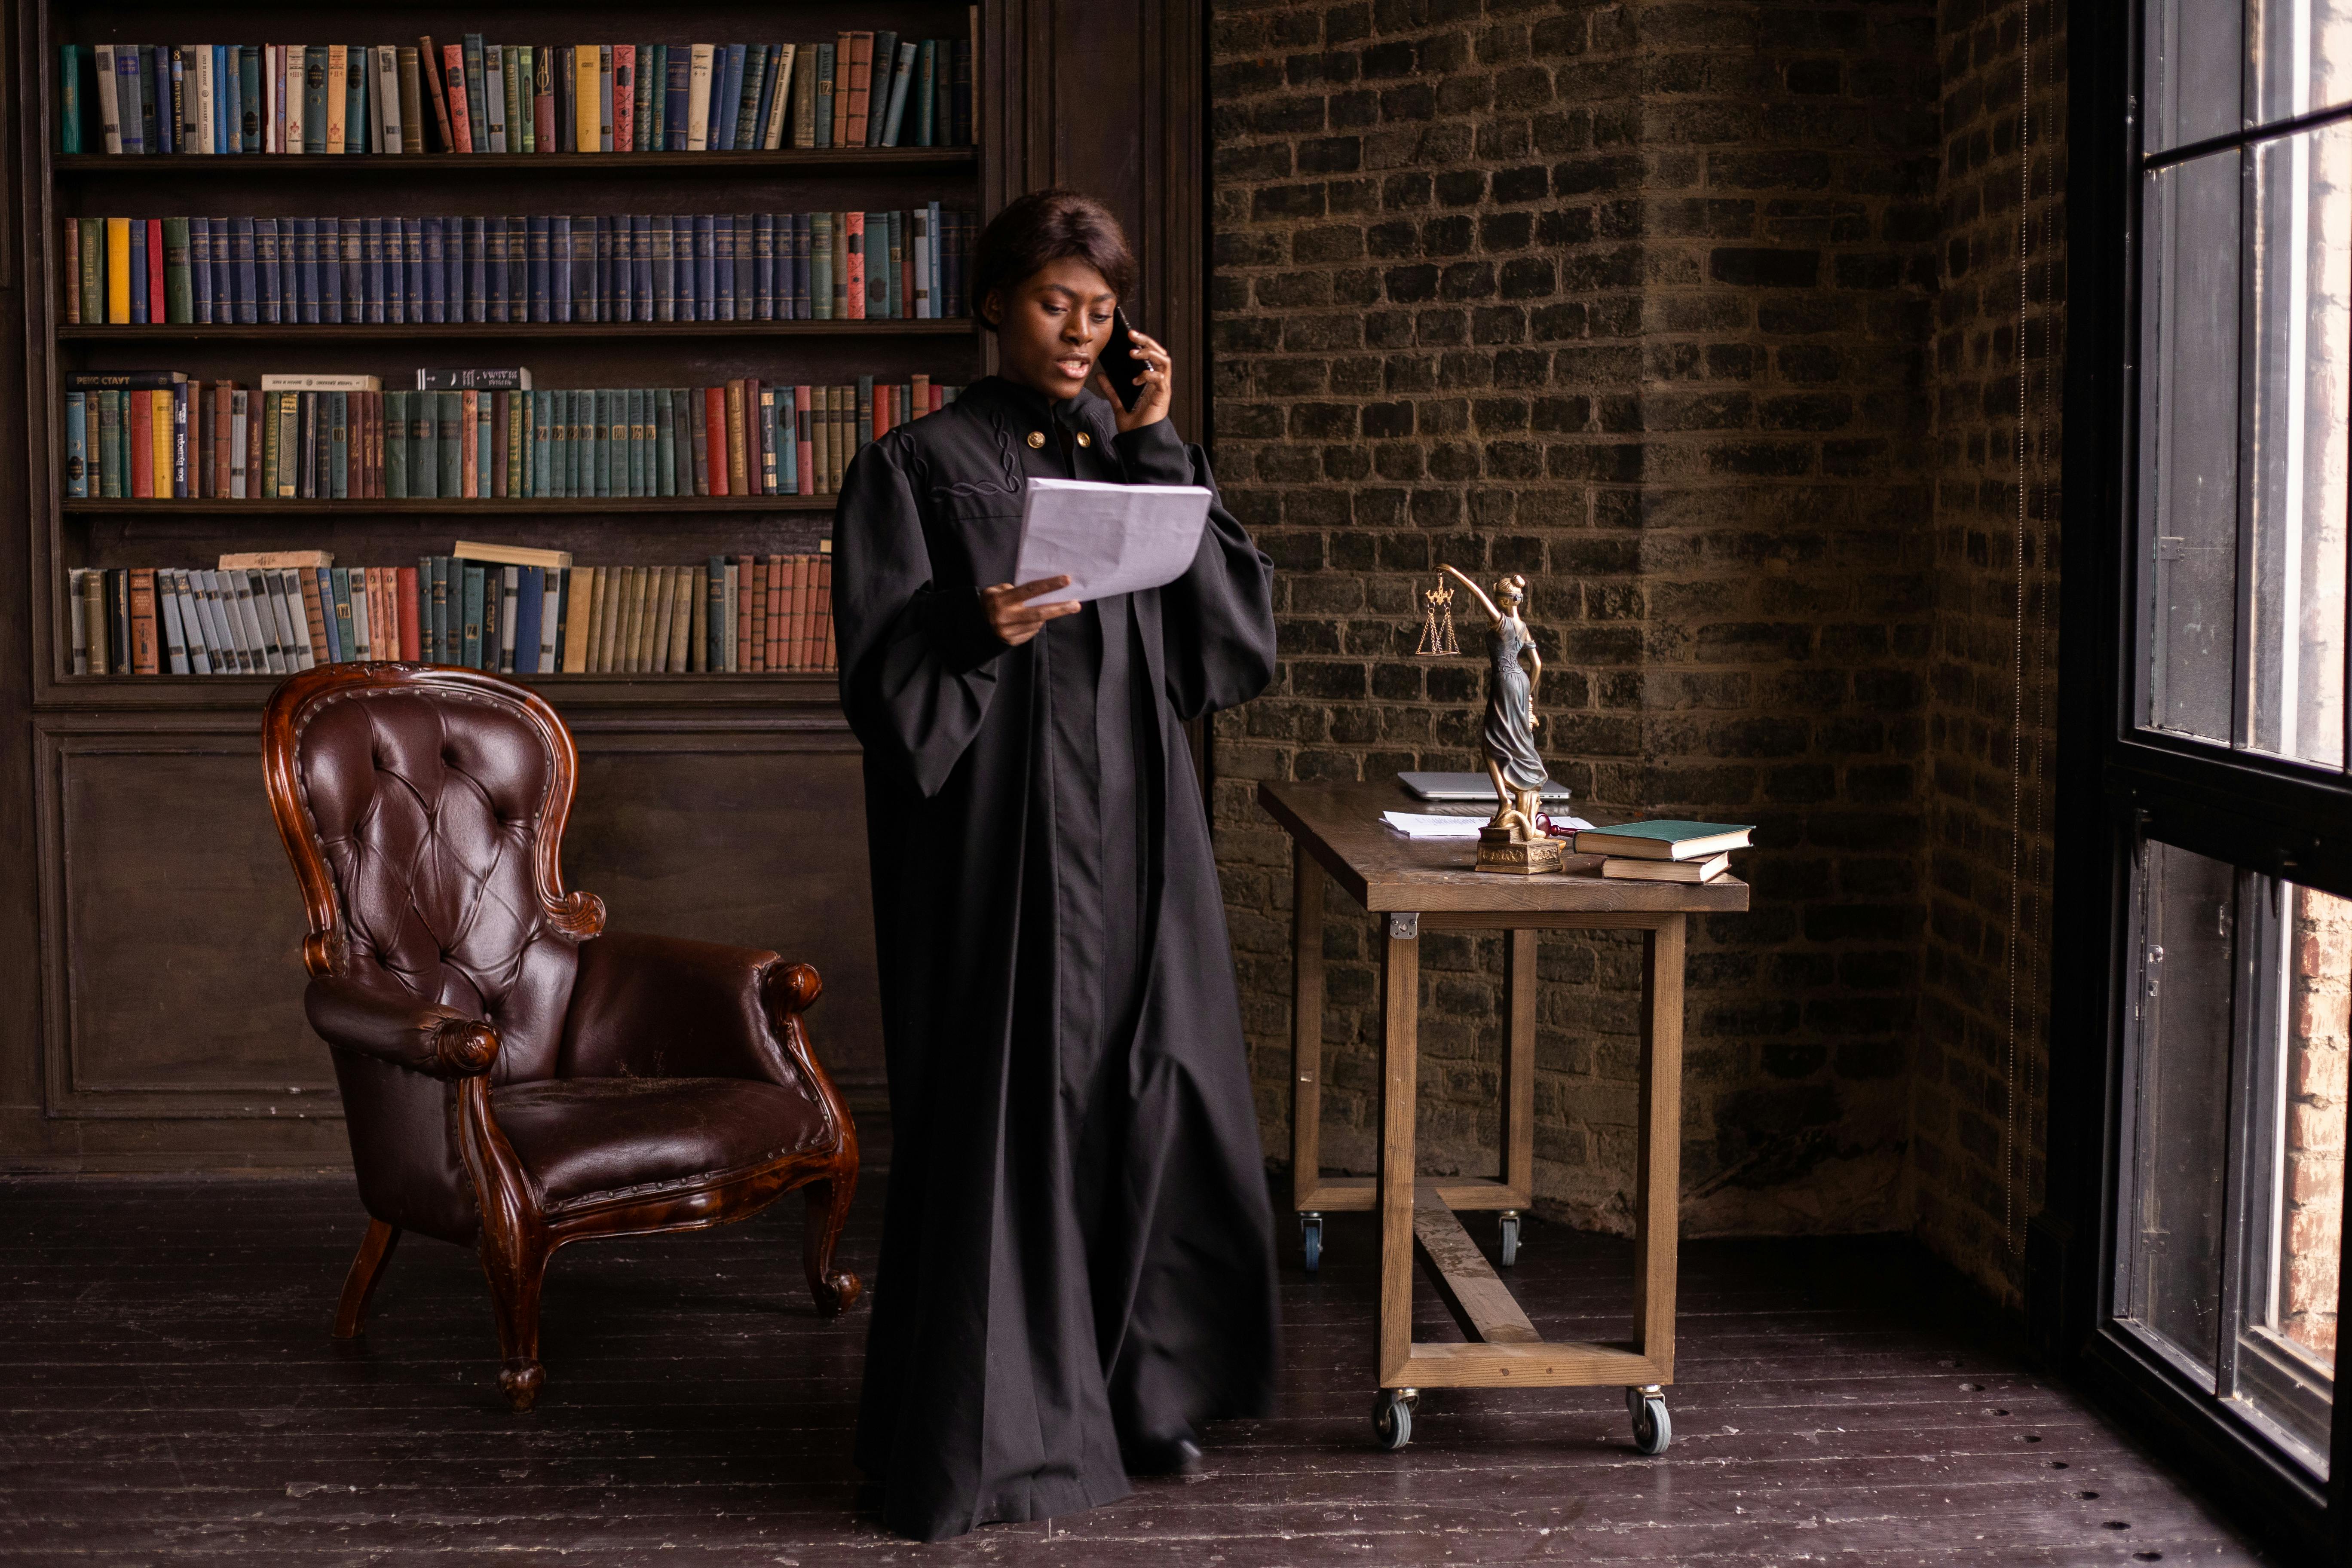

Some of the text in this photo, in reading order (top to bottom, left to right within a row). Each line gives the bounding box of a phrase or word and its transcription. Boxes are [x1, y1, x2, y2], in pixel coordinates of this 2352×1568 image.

[173, 50, 181, 60] 8
[482, 371, 517, 379] ВЕДЬМА
[76, 376, 98, 384] РЕКС
[101, 377, 130, 385] СТАУТ
